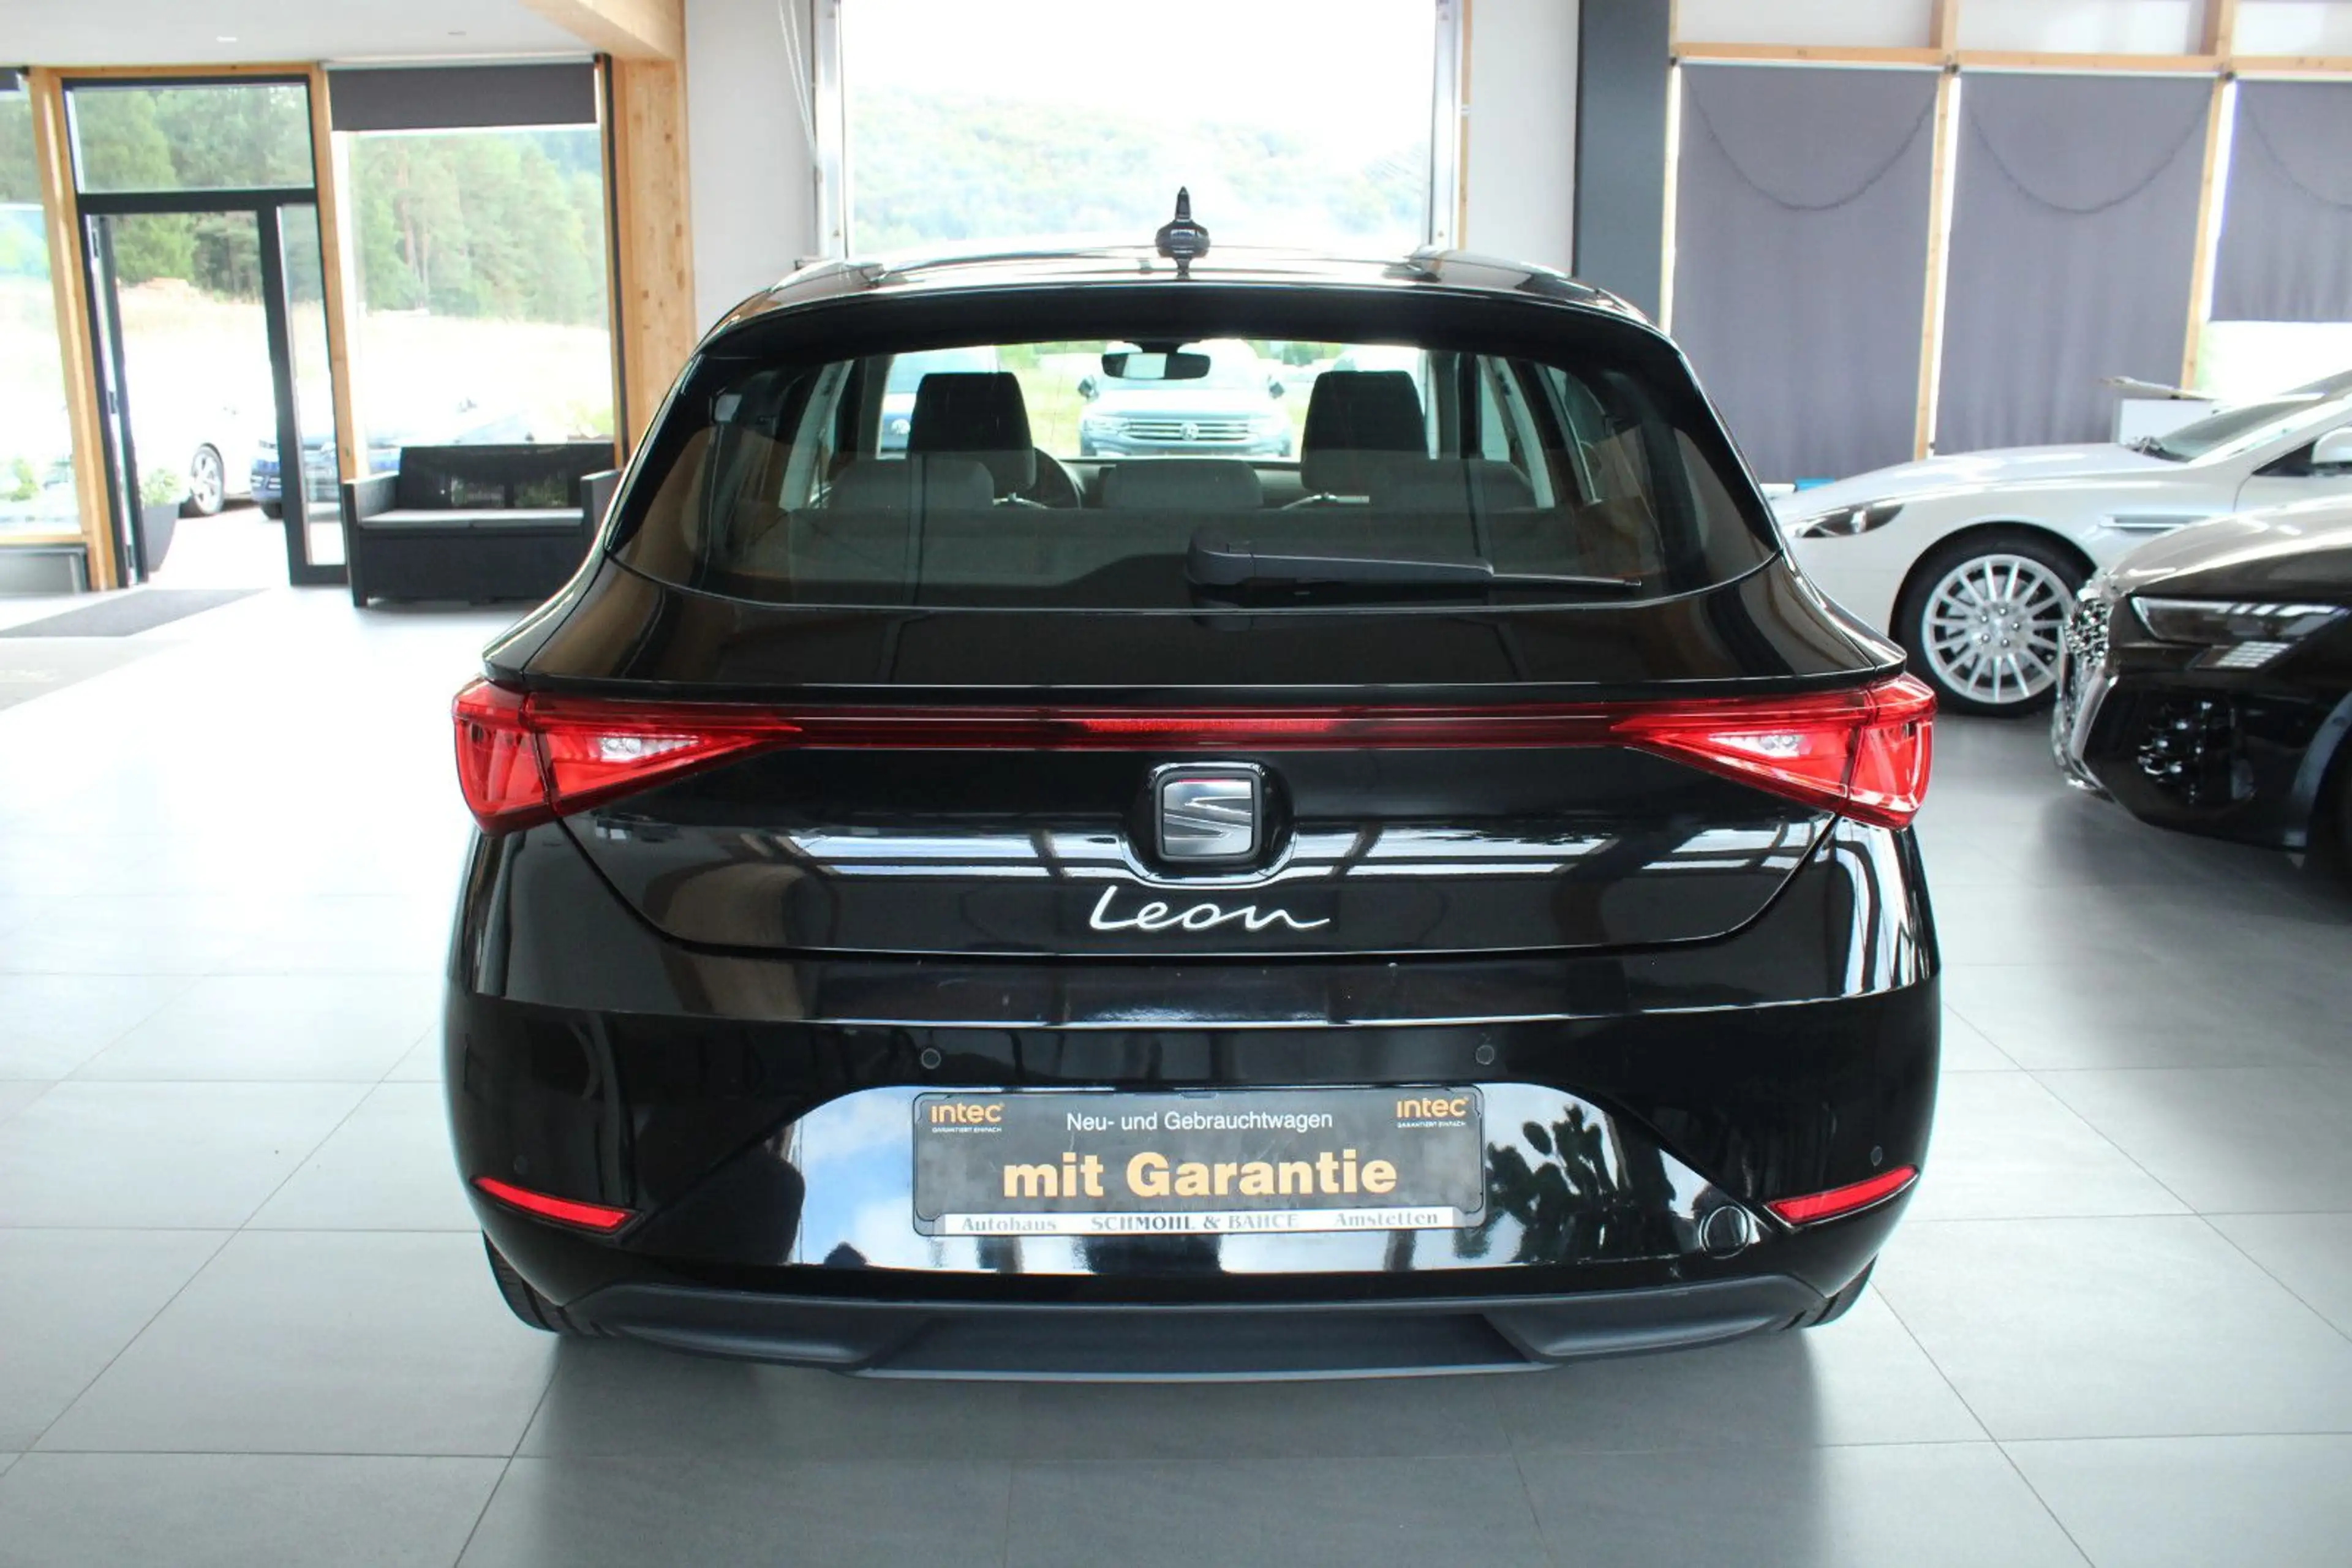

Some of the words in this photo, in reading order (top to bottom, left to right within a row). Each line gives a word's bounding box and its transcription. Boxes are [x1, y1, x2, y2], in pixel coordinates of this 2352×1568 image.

[1089, 885, 1330, 930] Leon
[931, 1102, 1002, 1123] intec
[1397, 1097, 1466, 1118] intec
[1067, 1113, 1114, 1131] Neu-
[1121, 1112, 1158, 1129] und
[1164, 1111, 1333, 1133] Gebrauchtwagen
[1003, 1152, 1104, 1197] mit
[1126, 1148, 1398, 1196] Garantie
[962, 1216, 1057, 1232] Autohaus
[1202, 1215, 1221, 1231] &
[1334, 1212, 1438, 1226] Amstetten
